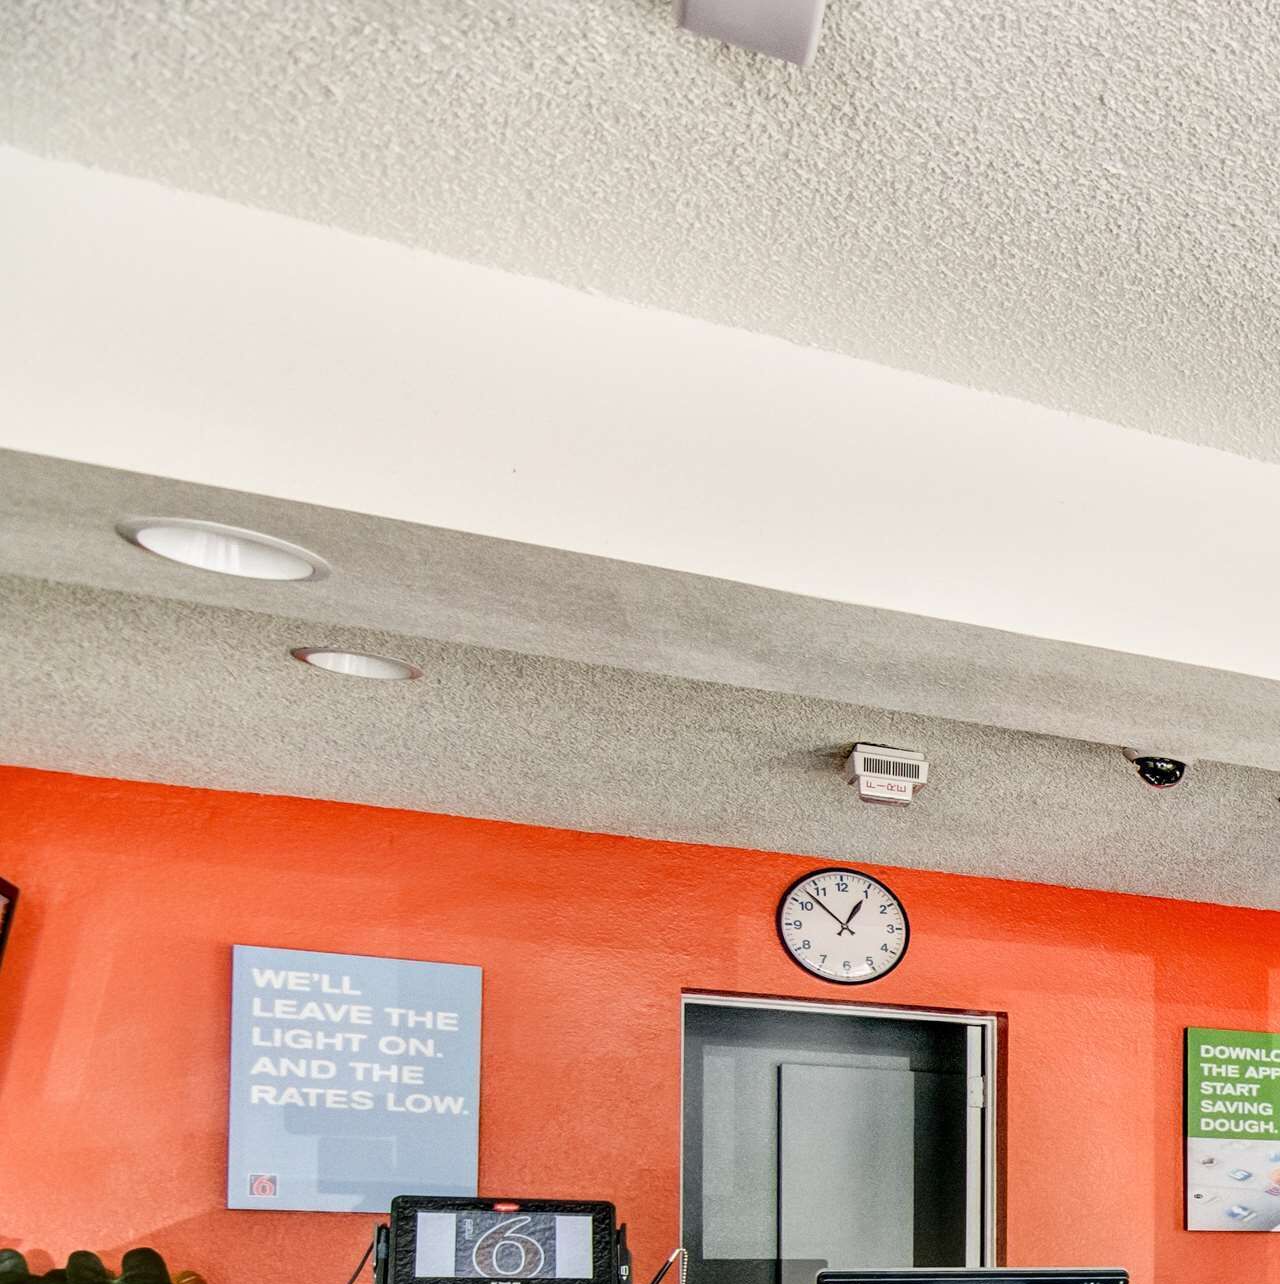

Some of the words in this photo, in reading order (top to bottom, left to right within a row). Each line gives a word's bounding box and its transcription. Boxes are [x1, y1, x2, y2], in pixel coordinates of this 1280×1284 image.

[866, 782, 907, 793] FIRE
[815, 887, 827, 897] 11
[836, 882, 849, 892] 12
[863, 890, 869, 899] 1
[800, 901, 813, 911] 10
[879, 905, 888, 914] 2
[793, 920, 802, 930] 9
[887, 924, 895, 934] 3
[802, 940, 812, 950] 8
[880, 943, 889, 952] 4
[819, 954, 827, 963] 7
[865, 956, 874, 966] 5
[842, 960, 852, 970] 6
[252, 997, 373, 1025] LEAVE
[384, 1007, 459, 1032] THE
[252, 1026, 367, 1052] LIGHT
[378, 1036, 444, 1058] ON.
[250, 1056, 337, 1080] AND
[349, 1061, 425, 1085] THE
[1200, 1063, 1239, 1078] THE
[1201, 1082, 1260, 1096] START
[250, 1085, 375, 1111] RATES
[386, 1093, 470, 1116] LOW.
[1201, 1100, 1273, 1115] SAVING
[1201, 1118, 1278, 1133] DOUGH.
[472, 1215, 545, 1279] 6
